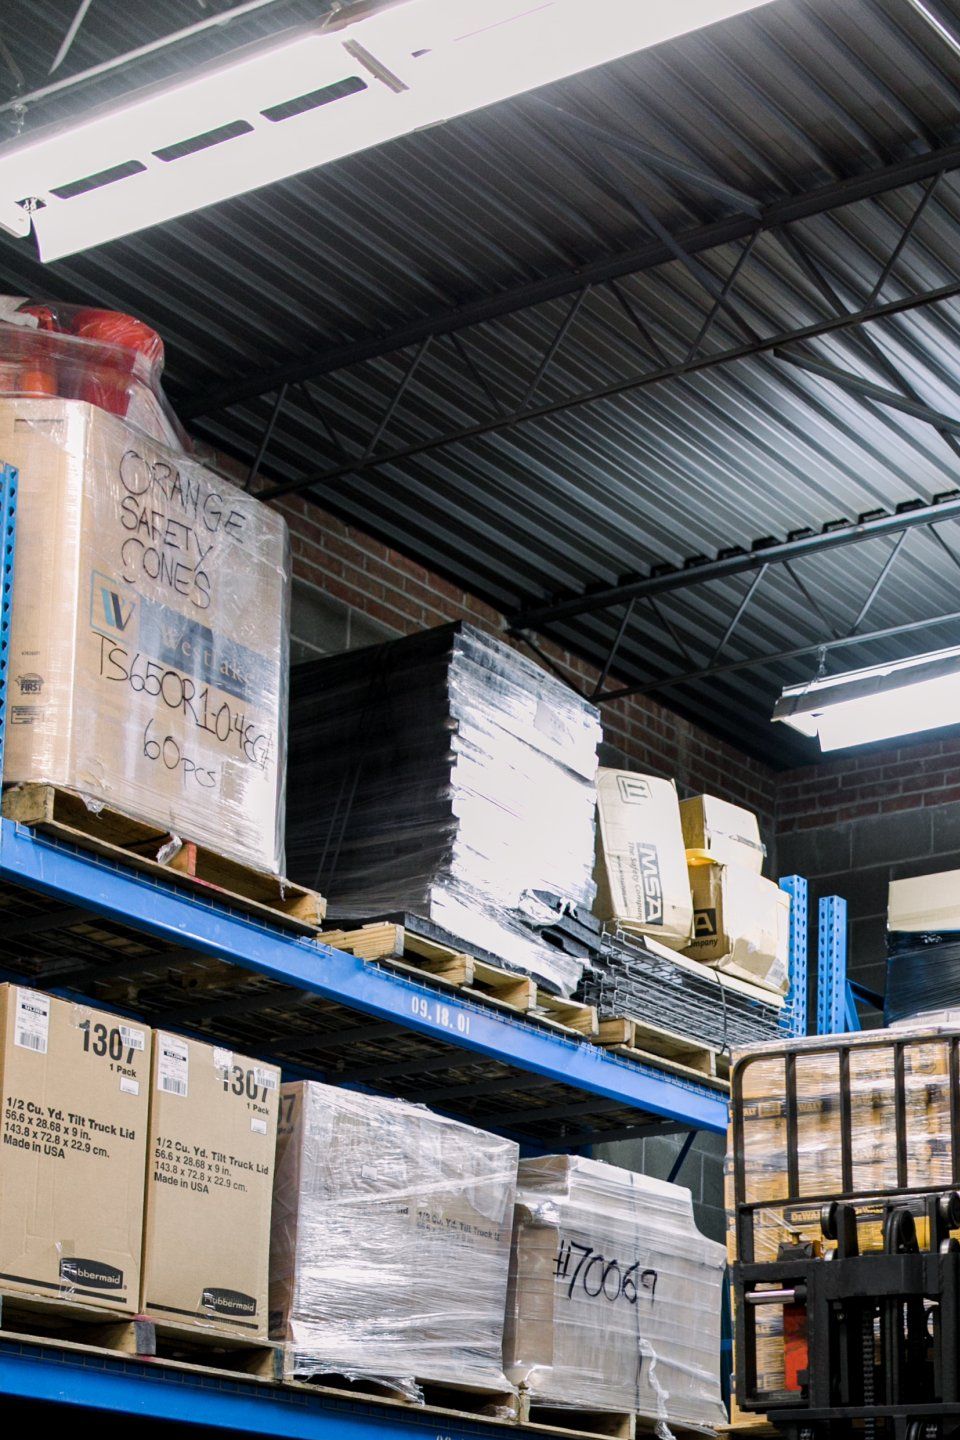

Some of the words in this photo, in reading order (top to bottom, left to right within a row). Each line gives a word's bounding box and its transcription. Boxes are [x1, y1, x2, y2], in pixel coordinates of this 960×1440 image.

[119, 450, 246, 544] ORANGE
[120, 495, 214, 573] SAFETY
[121, 537, 211, 610] CONES
[638, 847, 664, 921] MSA
[109, 1063, 115, 1072] 1
[116, 1064, 137, 1078] Pack
[5, 1110, 25, 1123] 56.6
[36, 1117, 61, 1131] 28.68
[63, 1127, 69, 1135] x
[72, 1125, 78, 1136] 9
[80, 1128, 91, 1140] in.
[6, 1096, 25, 1111] 1/2
[27, 1101, 44, 1116] Cu.
[48, 1107, 65, 1121] Yd.
[67, 1113, 86, 1127] Tilt
[88, 1118, 117, 1136] Truck
[119, 1127, 135, 1140] Lid
[252, 1104, 270, 1116] Pack
[3, 1133, 31, 1152] Made
[32, 1141, 41, 1153] in
[44, 1144, 65, 1159] USA
[4, 1121, 30, 1137] 143.8
[40, 1131, 60, 1145] 72.8
[71, 1139, 91, 1153] 22.9
[92, 1146, 110, 1158] cm.
[156, 1136, 172, 1149] 1/2
[174, 1141, 190, 1154] Cu.
[193, 1146, 208, 1158] Yd.
[211, 1151, 226, 1164] Tilt
[229, 1155, 254, 1171] Truck
[256, 1162, 269, 1175] Lid
[155, 1149, 173, 1161] 56.6
[183, 1156, 205, 1169] 28.68
[214, 1163, 220, 1173] 9
[222, 1166, 232, 1177] in.
[155, 1161, 178, 1174] 143.8
[187, 1169, 205, 1181] 72.8
[214, 1176, 231, 1188] 22.9
[233, 1181, 248, 1193] cm.
[154, 1172, 178, 1186] Made
[180, 1178, 188, 1189] in
[190, 1180, 209, 1194] USA
[459, 1221, 471, 1234] Tilt
[473, 1225, 494, 1239] Truck
[552, 1239, 658, 1308] #70069
